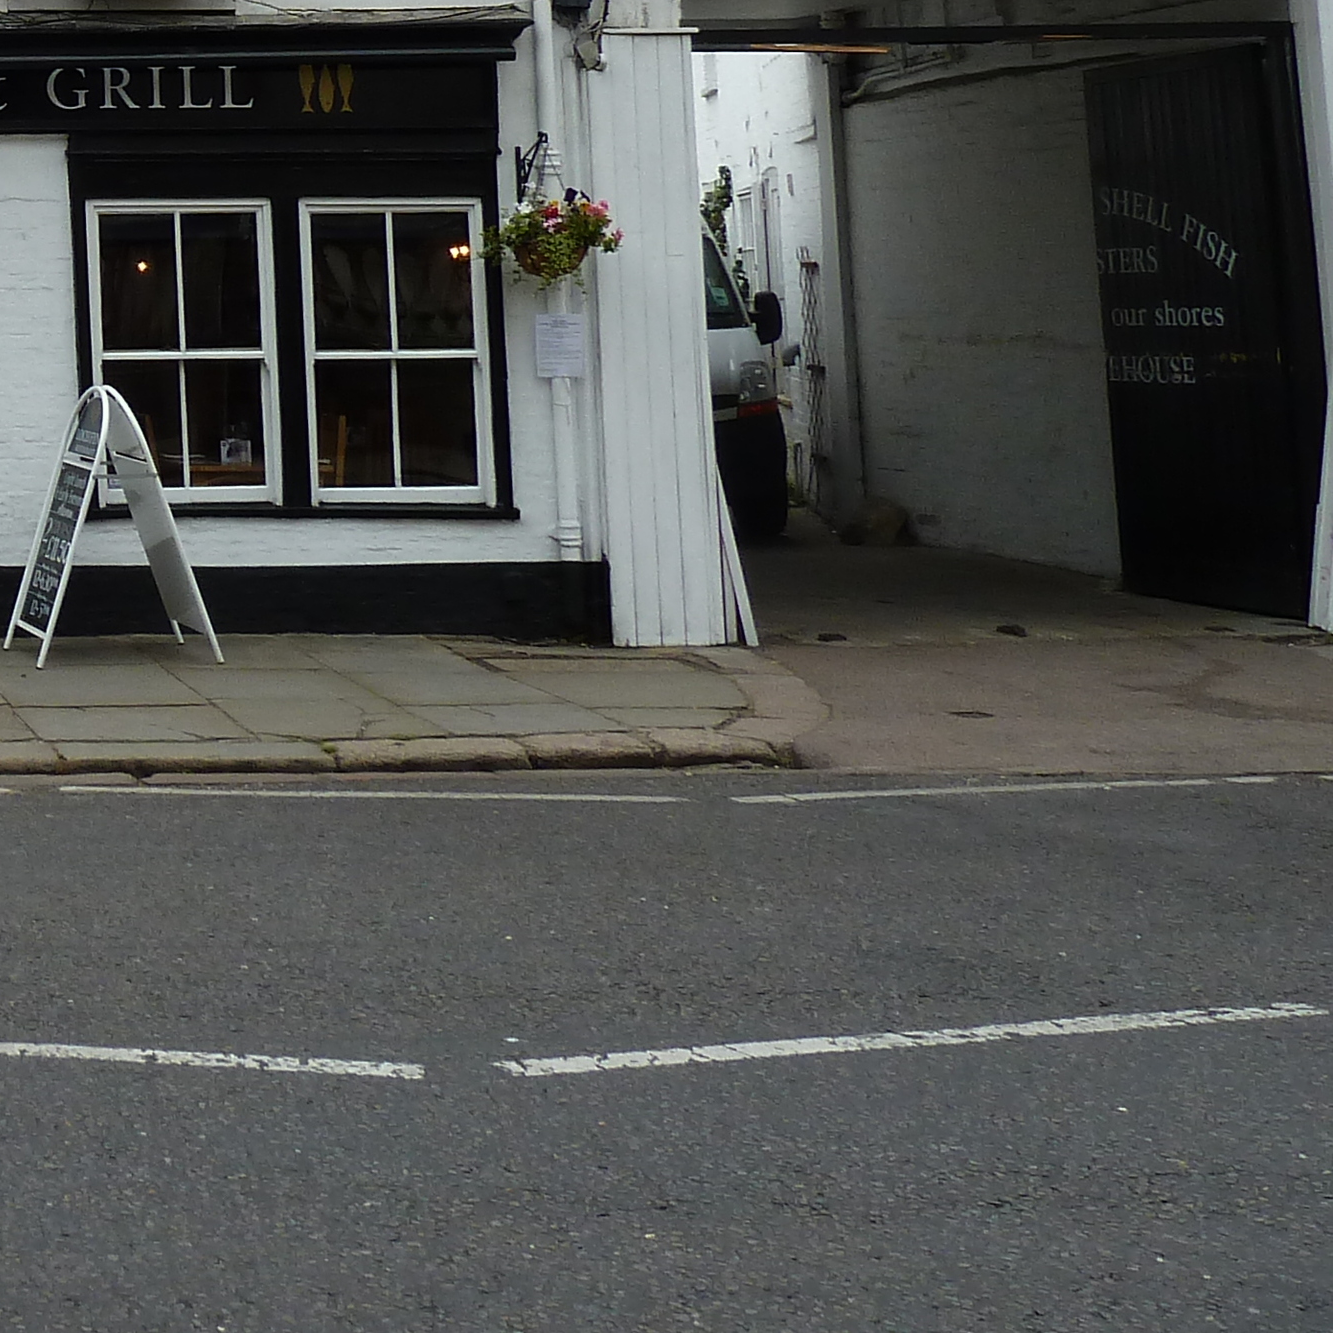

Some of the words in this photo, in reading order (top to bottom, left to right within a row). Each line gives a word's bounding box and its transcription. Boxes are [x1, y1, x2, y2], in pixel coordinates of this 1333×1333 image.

[45, 65, 256, 111] GRILL
[1099, 186, 1173, 233] SHELL
[1180, 213, 1239, 279] FISH
[1111, 307, 1148, 327] our
[1154, 299, 1226, 328] shores
